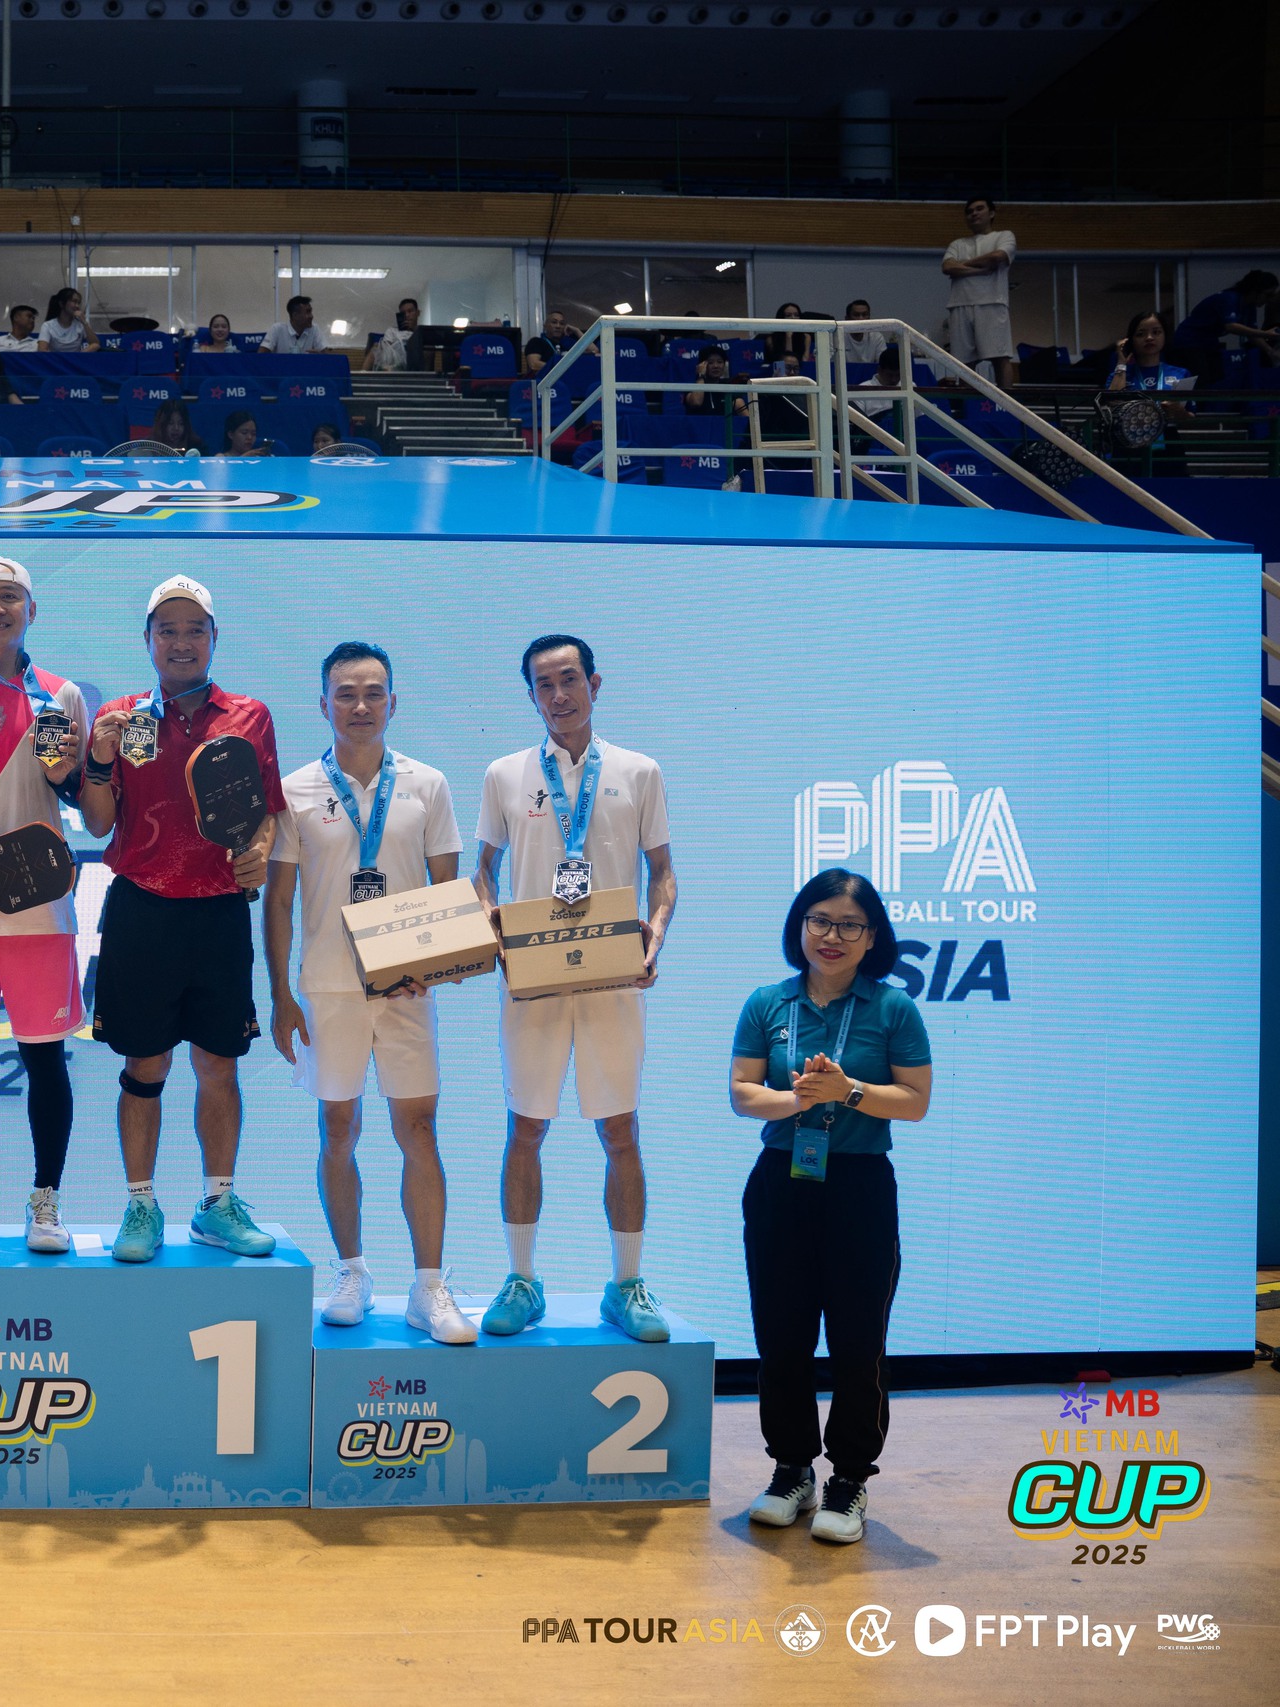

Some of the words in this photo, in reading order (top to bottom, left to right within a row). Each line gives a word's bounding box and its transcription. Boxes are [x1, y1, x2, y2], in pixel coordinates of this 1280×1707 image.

[145, 340, 164, 350] MB
[487, 345, 505, 355] MB
[620, 348, 637, 358] MB
[70, 388, 89, 398] MB
[149, 389, 169, 399] MB
[226, 386, 246, 397] MB
[306, 386, 326, 397] MB
[699, 456, 720, 468] MB
[955, 464, 977, 475] MB
[125, 732, 154, 744] CUP
[380, 779, 391, 798] ASIA
[584, 774, 595, 793] ASIA
[376, 799, 386, 818] TOUR
[580, 793, 590, 812] TOUR
[372, 818, 381, 834] PPA
[577, 812, 586, 827] PPA
[794, 760, 1037, 892] PPA
[354, 890, 383, 900] CUP
[393, 901, 428, 913] zocker
[550, 909, 587, 921] zocker
[961, 900, 1037, 922] TOUR
[376, 908, 457, 934] ASPIRE
[527, 925, 615, 945] ASPIRE
[424, 961, 485, 981] zocker
[893, 940, 1011, 1001] SIA
[800, 1156, 818, 1164] LOC
[6, 1318, 53, 1341] MB
[189, 1320, 257, 1455] 1
[395, 1379, 427, 1395] MB
[357, 1402, 438, 1418] VIETNAM
[587, 1370, 669, 1475] 2
[337, 1419, 453, 1463] CUP
[373, 1467, 417, 1479] 2025
